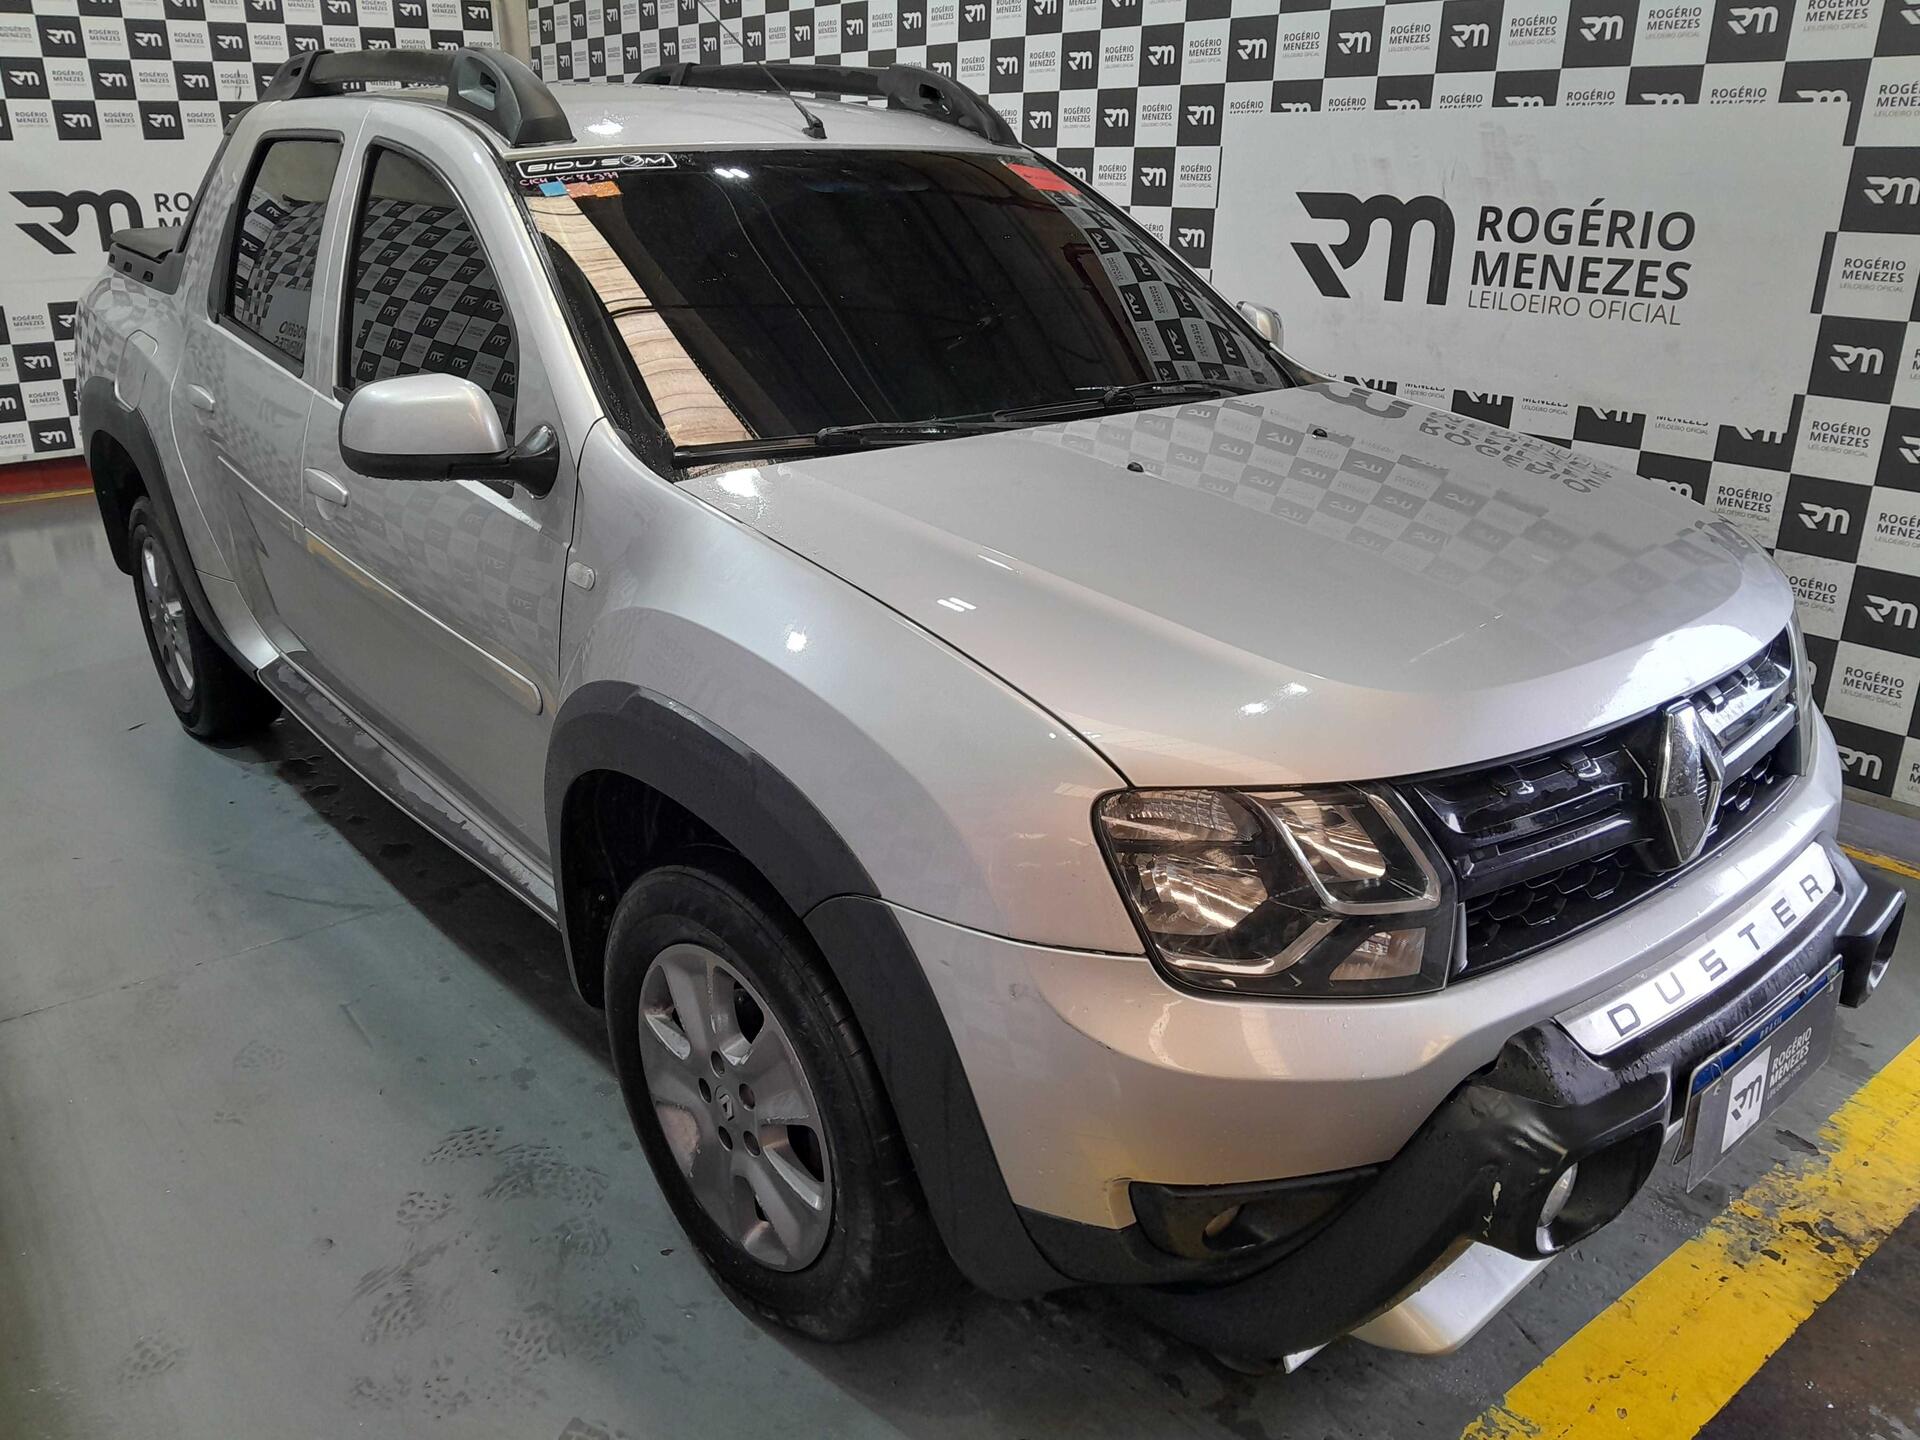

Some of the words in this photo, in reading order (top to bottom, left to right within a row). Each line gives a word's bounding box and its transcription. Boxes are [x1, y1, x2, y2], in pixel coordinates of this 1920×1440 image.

[931, 4, 954, 14] ROGÉRIO
[996, 4, 1022, 14] MENEZES
[1648, 4, 1703, 19] ROGÉRIO
[1805, 7, 1870, 22] MENEZES
[931, 12, 954, 22] MENEZES
[1511, 13, 1559, 27] ROGÉRIO
[1646, 18, 1702, 30] MENEZES
[1728, 4, 1780, 34] RM
[1390, 22, 1432, 35] ROGÉRIO
[1451, 22, 1490, 48] RM
[1509, 26, 1558, 38] MENEZES
[1580, 14, 1625, 41] RM
[1189, 37, 1222, 48] ROGÉRIO
[1284, 30, 1321, 42] ROGÉRIO
[1338, 30, 1372, 54] RM
[1389, 34, 1431, 45] MENEZES
[1105, 44, 1134, 54] ROGÉRIO
[1188, 47, 1222, 57] MENEZES
[1237, 38, 1268, 60] RM
[1282, 41, 1320, 51] MENEZES
[962, 55, 985, 65] ROGÉRIO
[1029, 50, 1056, 60] ROGÉRIO
[1068, 50, 1093, 70] RM
[1104, 54, 1134, 63] MENEZES
[1148, 44, 1175, 66] RM
[961, 64, 985, 72] MENEZES
[996, 56, 1018, 75] RM
[1029, 59, 1056, 68] MENEZES
[1440, 92, 1484, 104] ROGÉRIO
[1566, 89, 1616, 102] ROGÉRIO
[1710, 86, 1768, 99] ROGÉRIO
[1142, 102, 1173, 112] ROGÉRIO
[1230, 99, 1264, 110] ROGÉRIO
[1328, 96, 1367, 107] ROGÉRIO
[1064, 106, 1091, 115] ROGÉRIO
[1104, 108, 1129, 128] RM
[1142, 113, 1172, 121] MENEZES
[1187, 105, 1215, 126] RM
[1029, 110, 1052, 129] RM
[1099, 163, 1127, 172] ROGÉRIO
[1180, 163, 1212, 173] ROGÉRIO
[1140, 167, 1167, 187] RM
[1180, 174, 1212, 182] MENEZES
[1477, 198, 1696, 251] ROGÉRIO
[1178, 228, 1206, 248] RM
[1290, 192, 1455, 305] RM
[1843, 257, 1908, 272] ROGÉRIO
[1471, 250, 1692, 300] MENEZES
[1841, 270, 1906, 284] MENEZES
[1468, 290, 1580, 318] LEILOEIRO
[1588, 300, 1681, 326] OFICIAL
[1831, 344, 1885, 375] RM
[1811, 420, 1872, 438] ROGÉRIO
[1809, 431, 1871, 449] MENEZES
[1718, 485, 1774, 503] ROGÉRIO
[1715, 496, 1772, 514] MENEZES
[1799, 502, 1851, 535] RM
[1788, 576, 1839, 594] OGÉRIO
[1865, 594, 1920, 630] RM
[1844, 666, 1906, 689] ROGÉRIO
[1841, 676, 1904, 700] MENEZES
[1606, 874, 1823, 1037] DUSTER
[1772, 1026, 1812, 1072] ROGÉRIO
[1770, 1041, 1810, 1088] MENEZES
